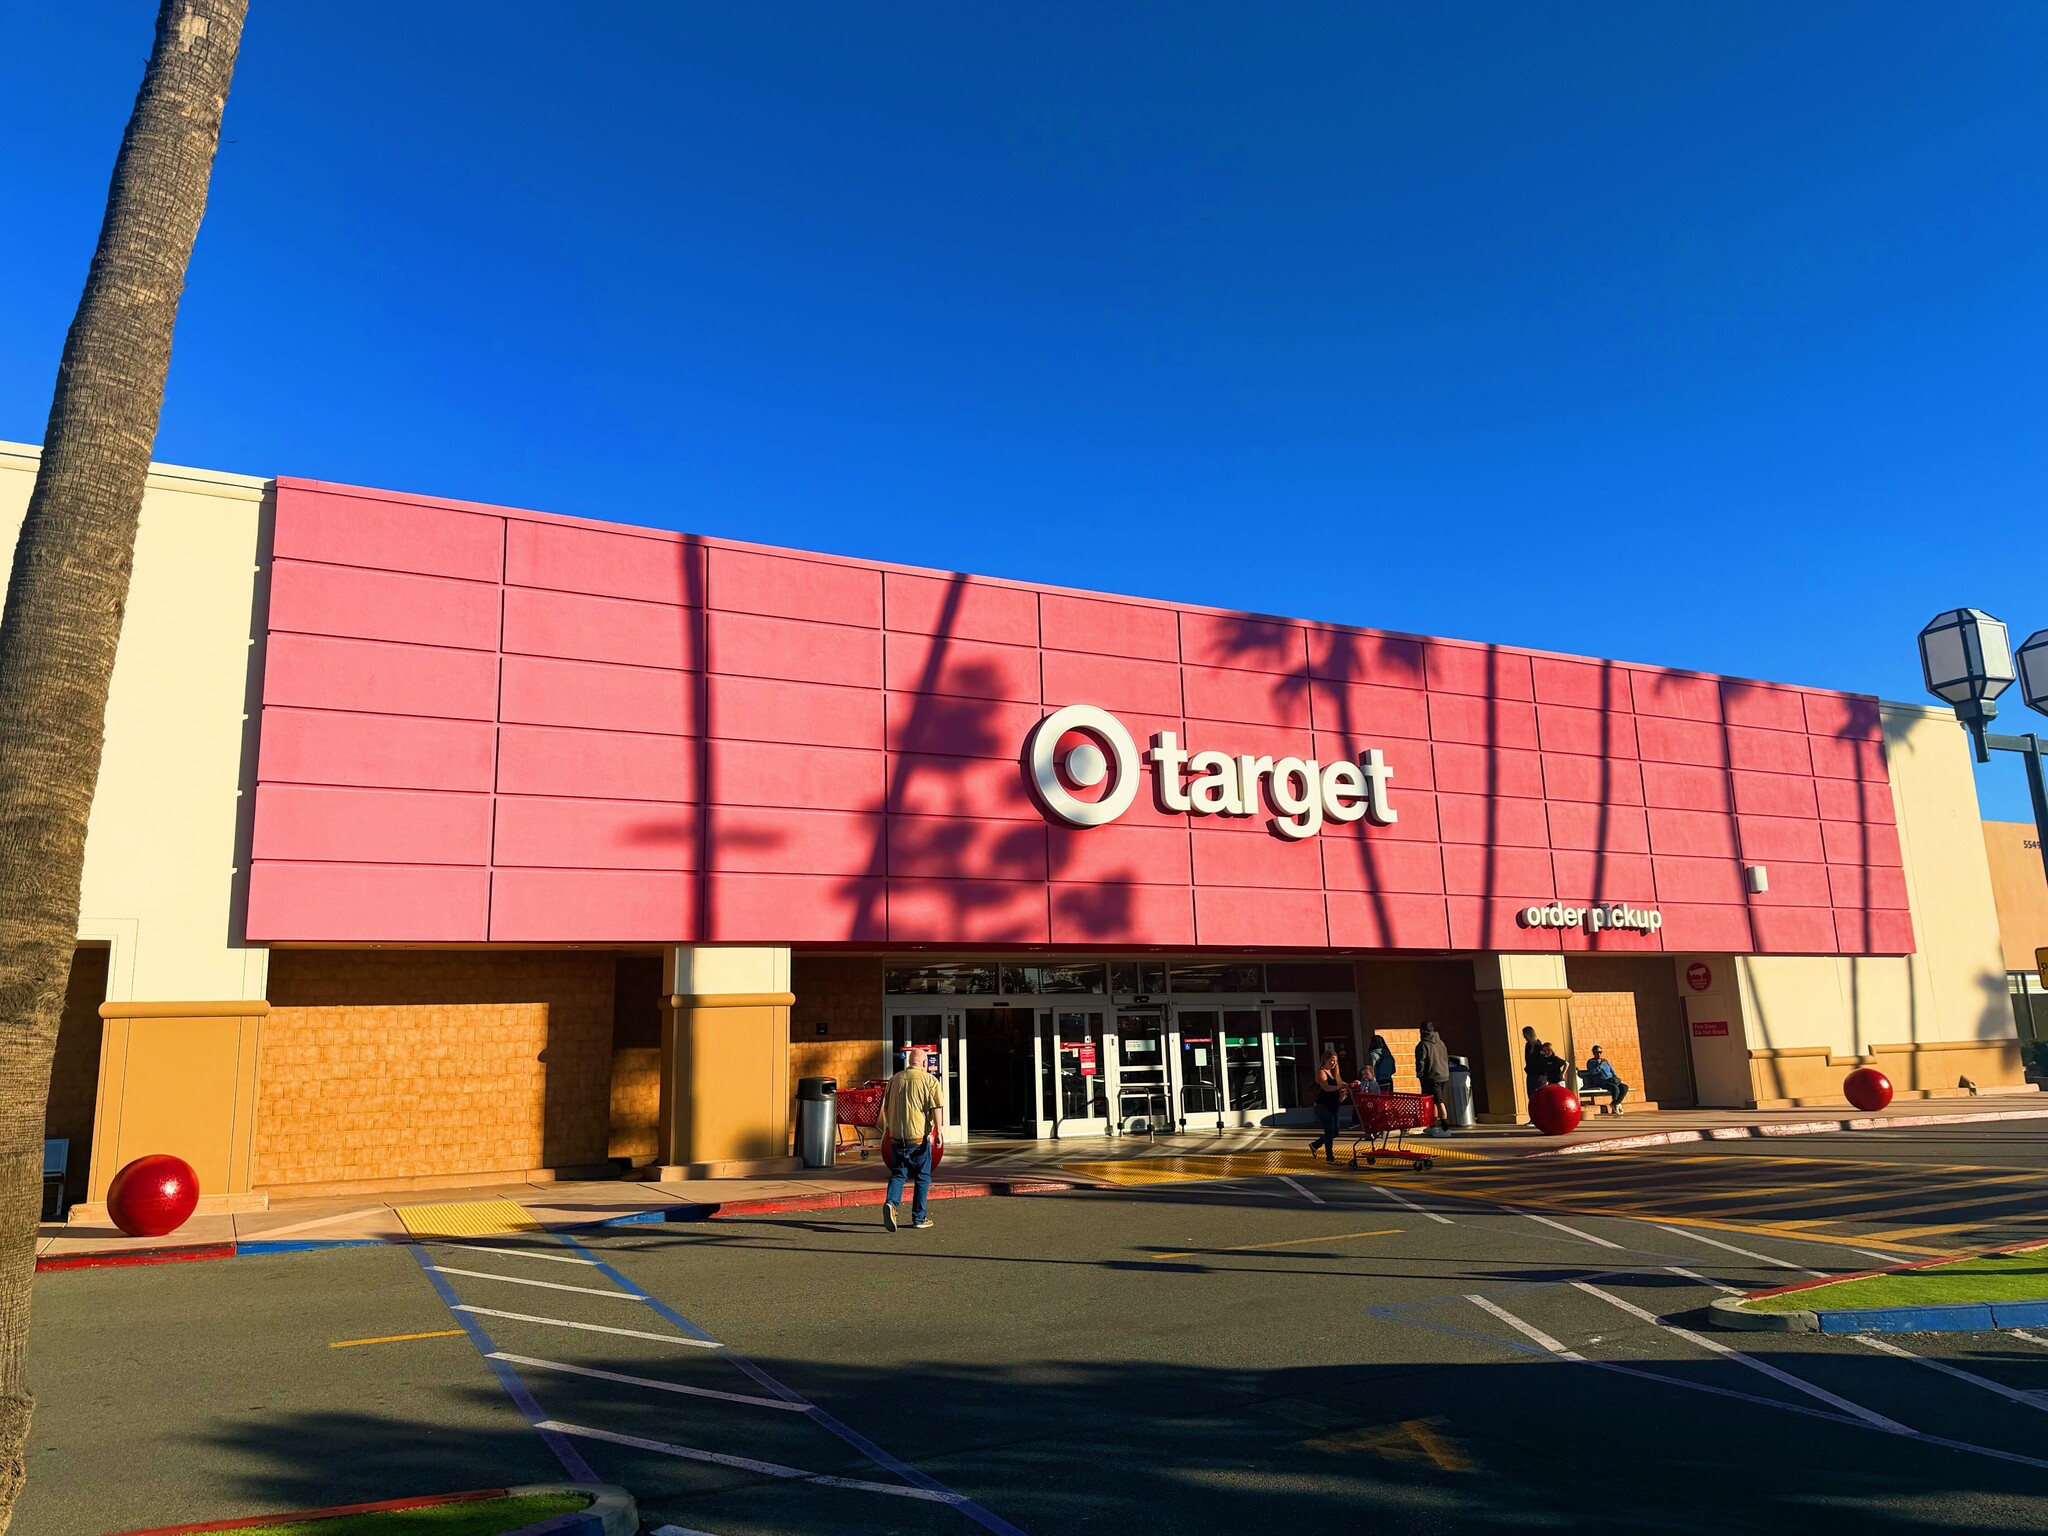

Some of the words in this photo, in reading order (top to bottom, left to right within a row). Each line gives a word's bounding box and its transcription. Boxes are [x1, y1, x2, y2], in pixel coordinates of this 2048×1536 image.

[1149, 730, 1398, 839] target
[1525, 902, 1587, 926] order
[1591, 903, 1662, 933] pickup
